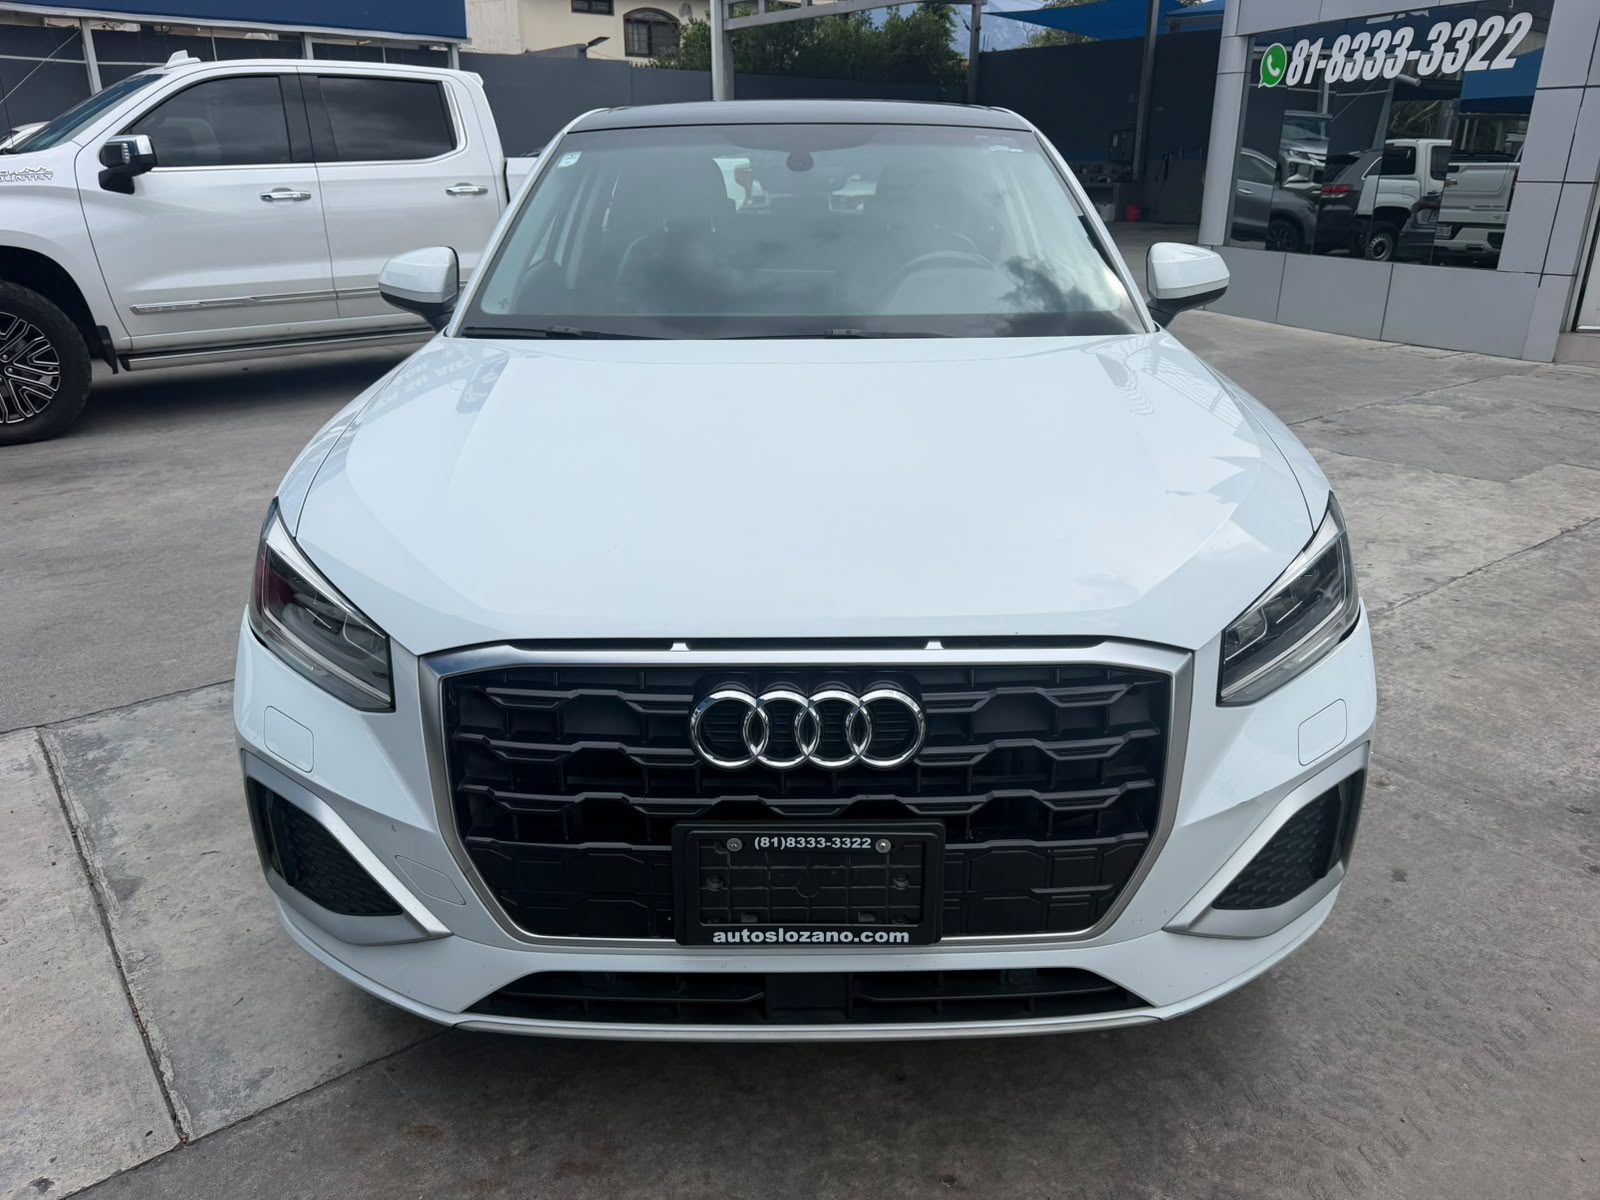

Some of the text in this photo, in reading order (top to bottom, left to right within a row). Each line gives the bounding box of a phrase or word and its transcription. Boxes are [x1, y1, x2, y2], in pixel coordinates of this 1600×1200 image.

[1286, 12, 1533, 86] 81-8333-3322
[754, 836, 872, 850] (81)8333-3322
[713, 928, 910, 943] autoslozano.com
